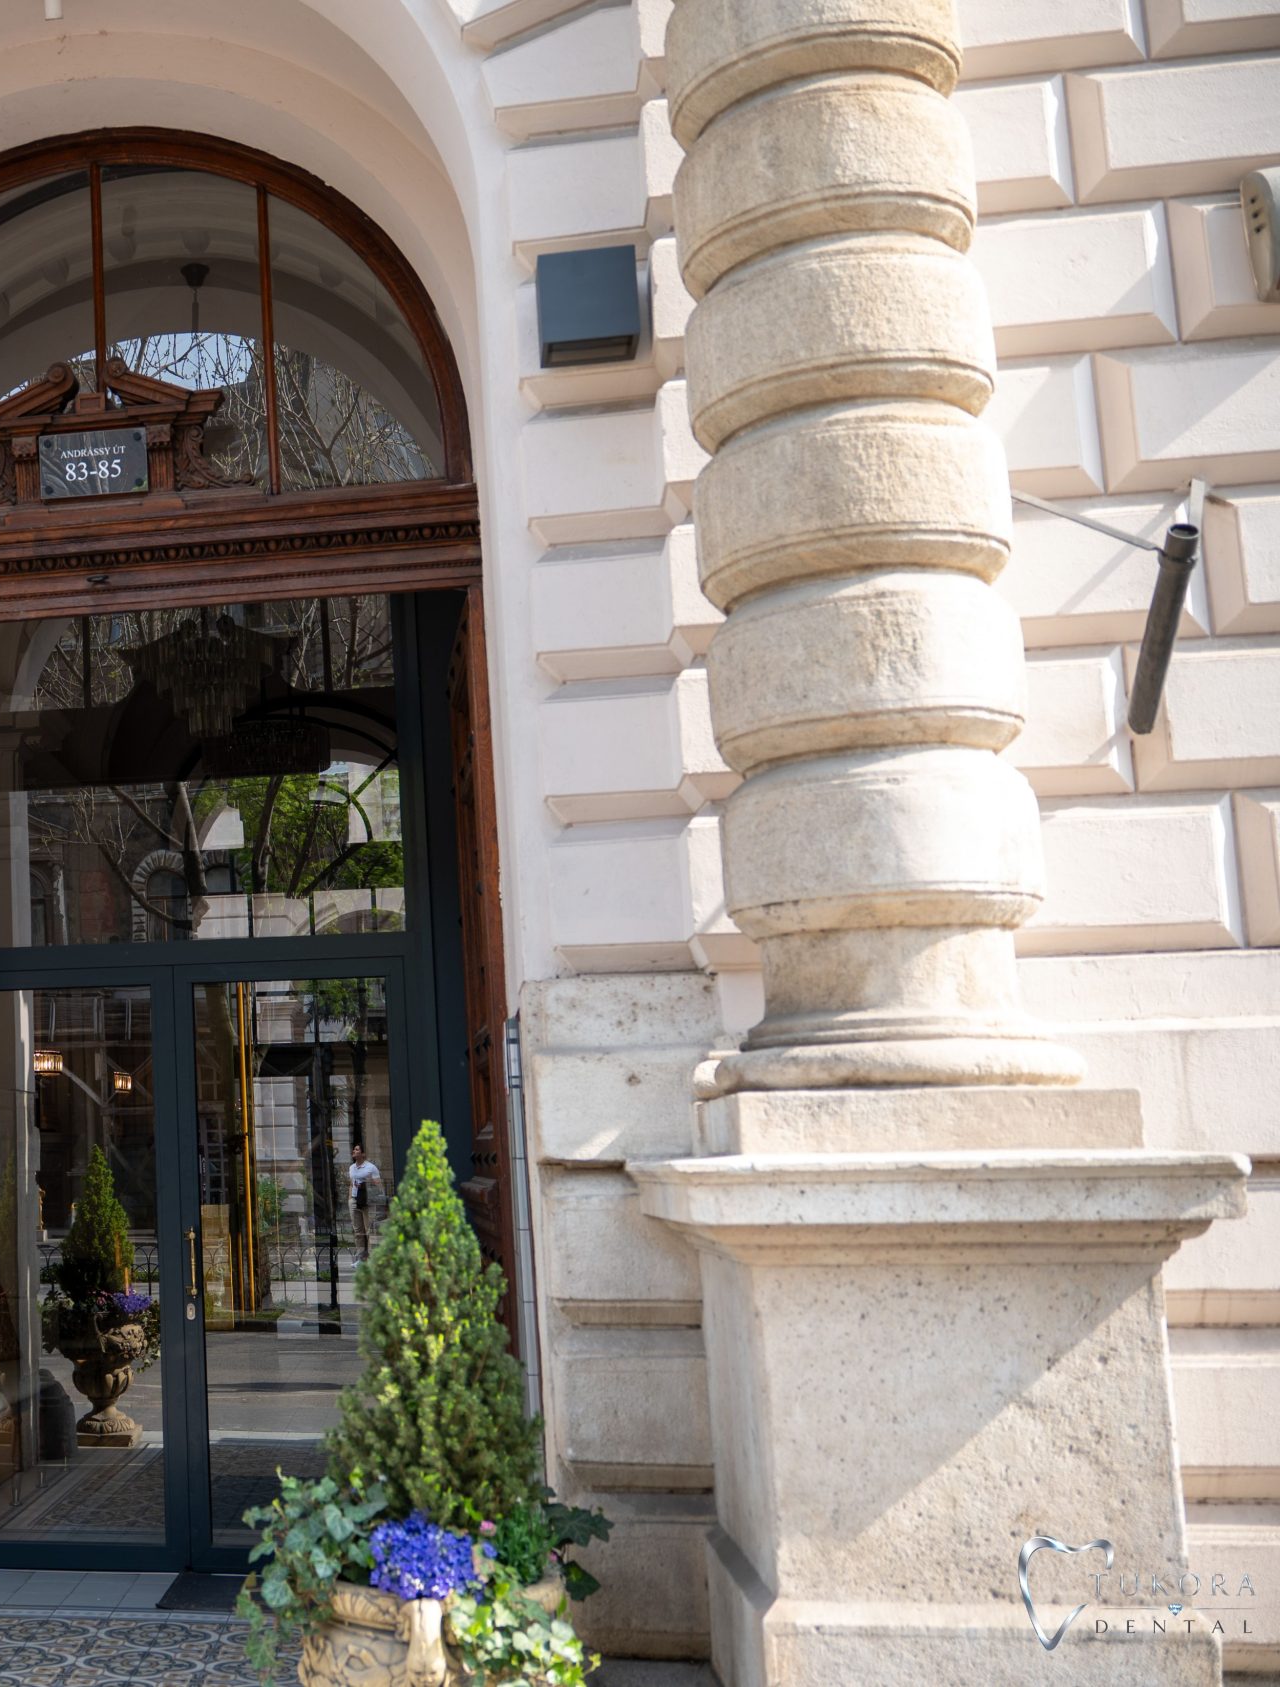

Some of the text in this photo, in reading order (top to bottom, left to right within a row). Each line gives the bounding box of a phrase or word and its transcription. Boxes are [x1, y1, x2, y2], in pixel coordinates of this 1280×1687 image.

[60, 444, 126, 459] ANDRÁSSY ÚT
[65, 459, 122, 481] 83-85
